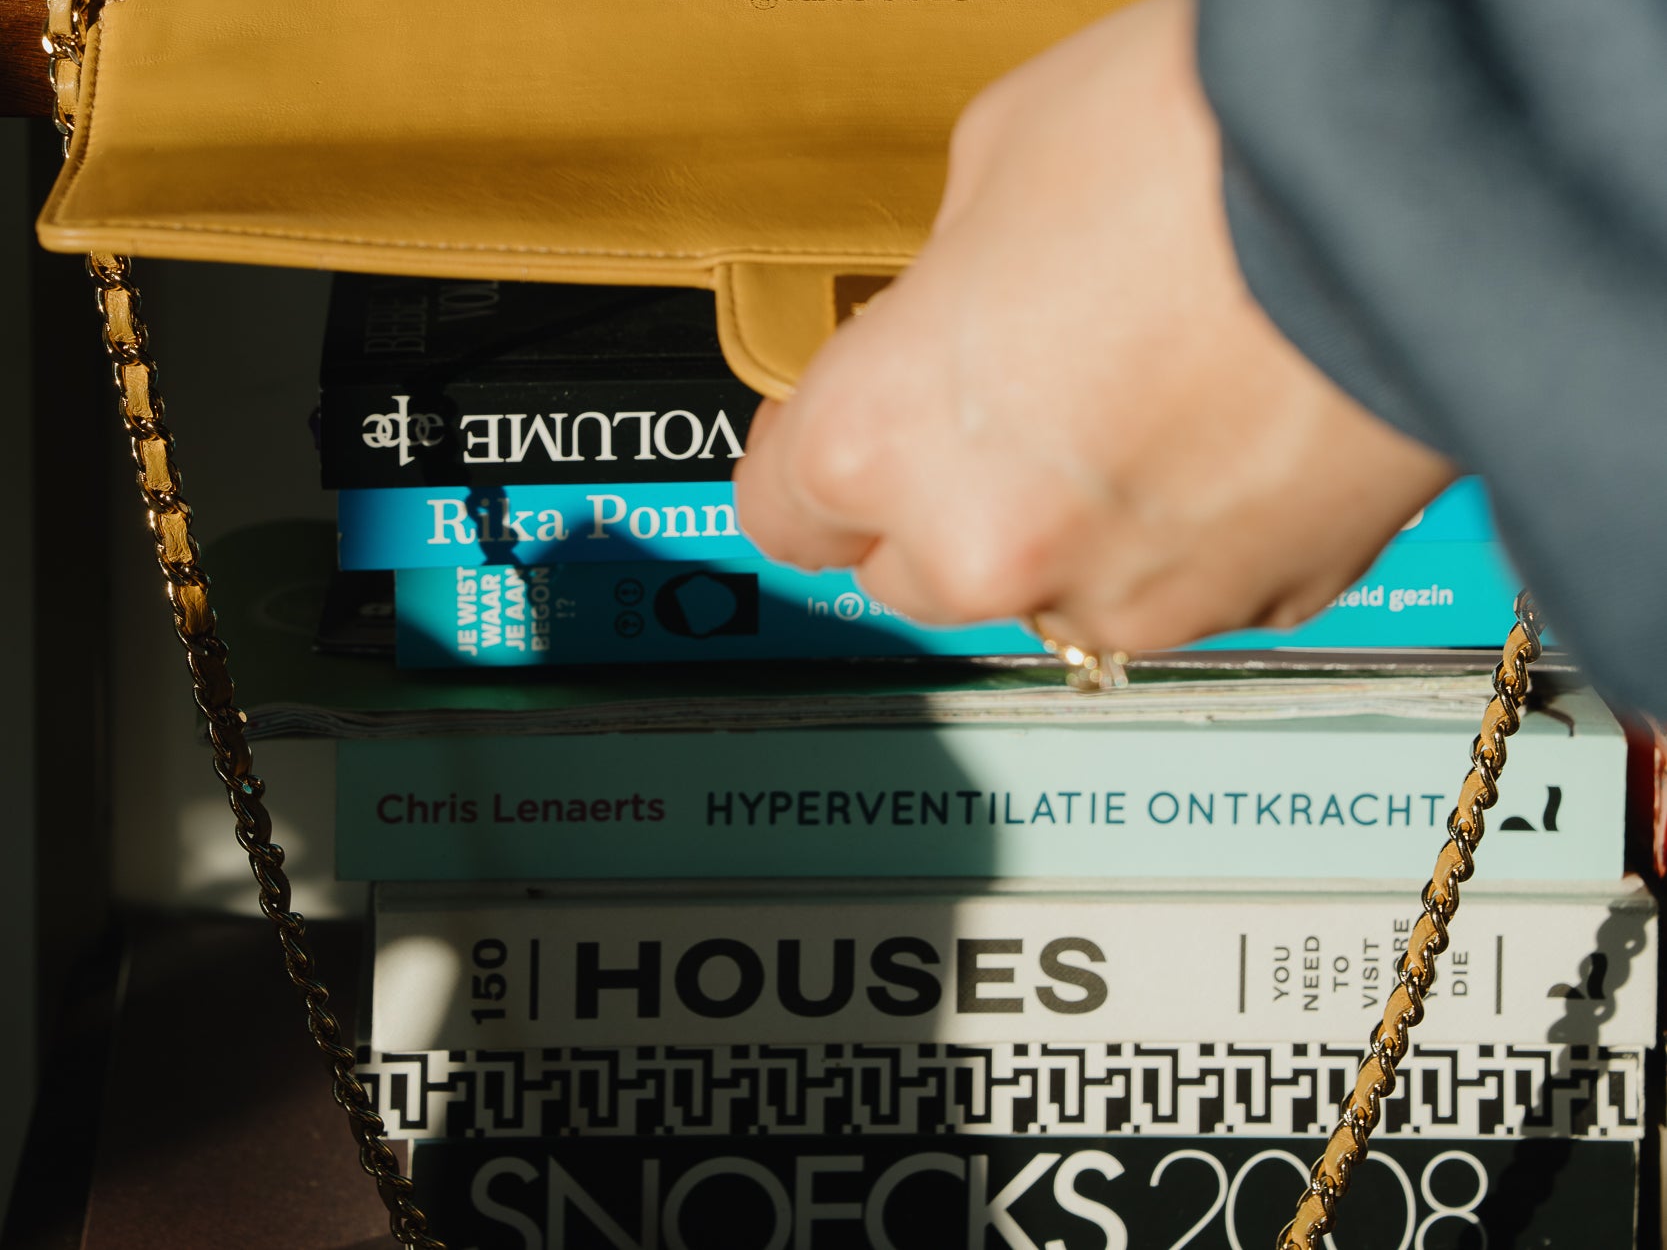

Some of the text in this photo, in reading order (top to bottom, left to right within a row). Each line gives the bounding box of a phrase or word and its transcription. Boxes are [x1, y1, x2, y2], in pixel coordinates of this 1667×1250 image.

[459, 408, 746, 464] VOLUME
[426, 497, 570, 546] Rika
[456, 566, 478, 657] JE WIST
[480, 573, 503, 649] WAAR
[504, 567, 526, 653] JE AAN
[530, 566, 551, 653] BEGON
[807, 596, 829, 617] In
[1388, 583, 1454, 612] gezin
[375, 790, 666, 826] Chris Lenaerts
[705, 790, 1446, 827] HYPERVENTILATIE ONTKRACHT
[470, 937, 509, 1026] 150
[574, 935, 1109, 1019] HOUSES
[1273, 945, 1291, 1002] YOU
[1303, 935, 1320, 1012] NEED
[1332, 955, 1349, 993] TO
[1362, 938, 1380, 1010] VISIT
[1452, 950, 1469, 997] DIE
